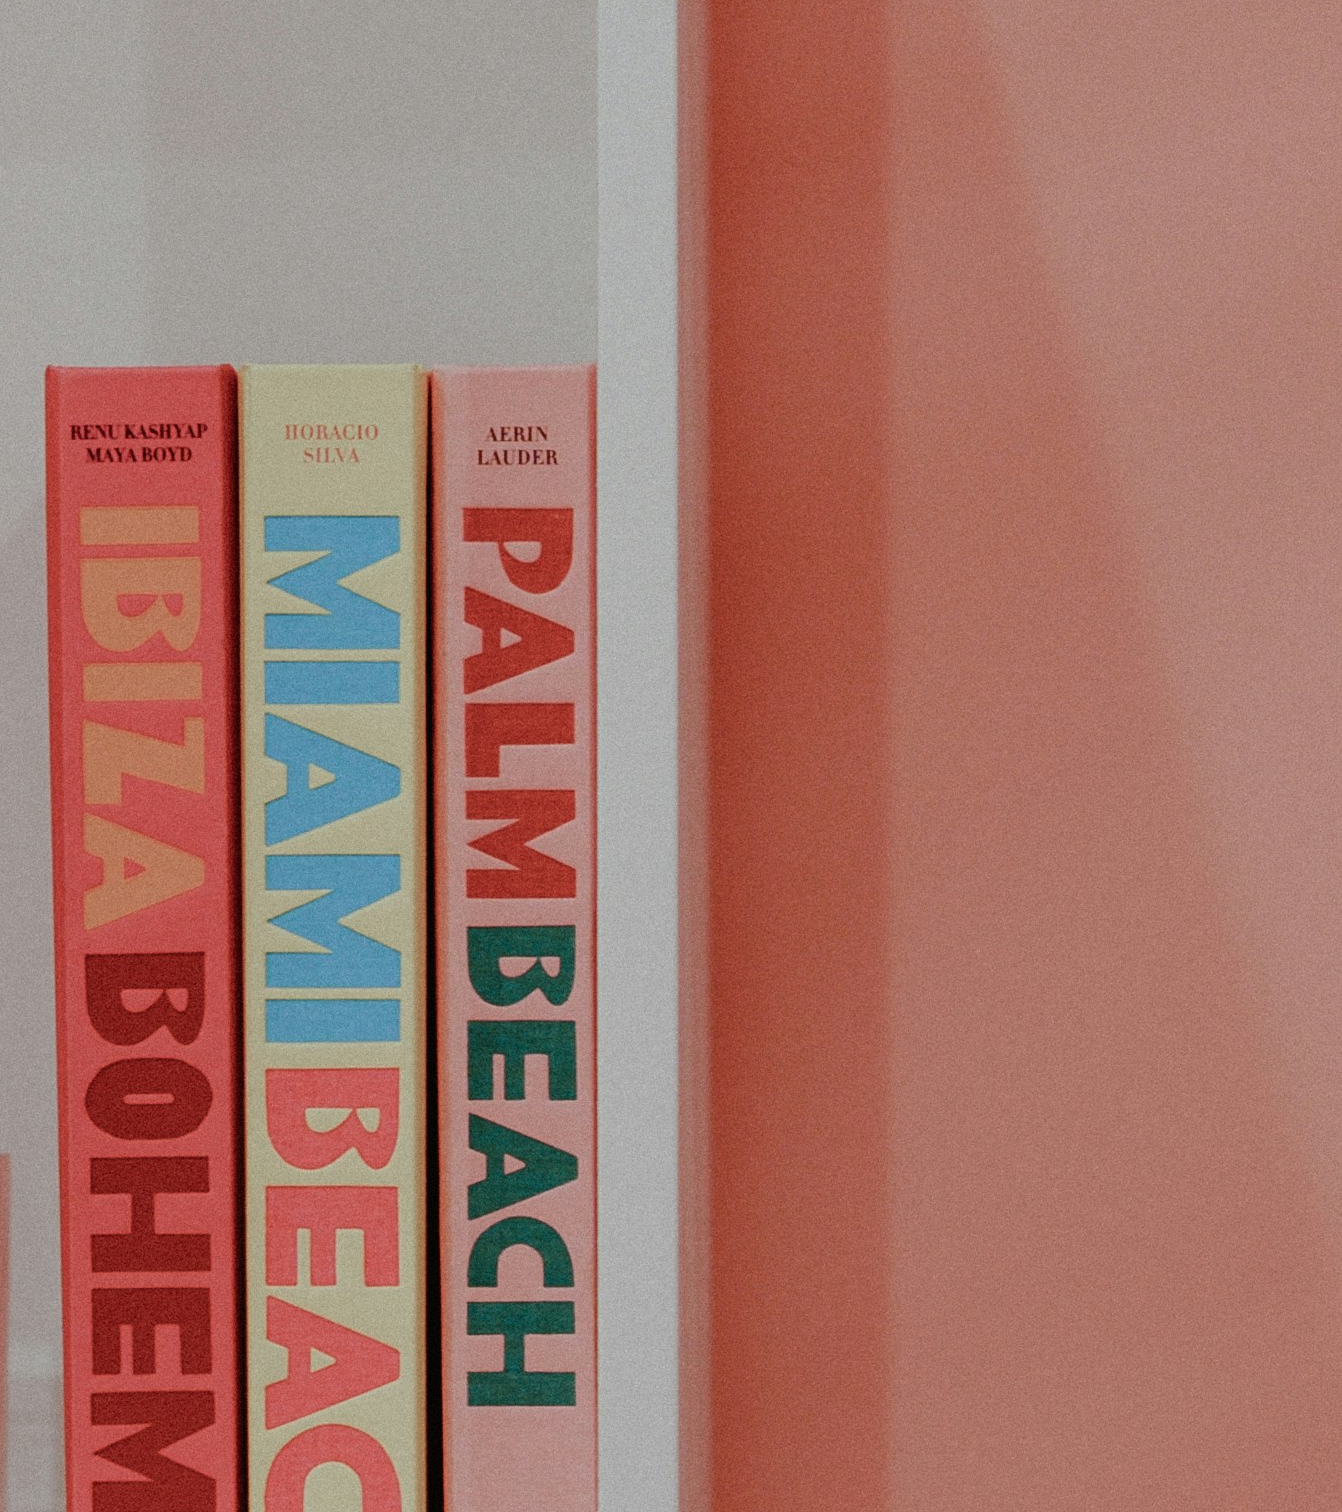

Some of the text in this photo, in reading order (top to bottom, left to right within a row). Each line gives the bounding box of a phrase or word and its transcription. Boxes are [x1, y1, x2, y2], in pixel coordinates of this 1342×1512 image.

[70, 423, 208, 440] RENU KASHYAP
[285, 424, 379, 441] HORACIO
[485, 426, 548, 443] AERIN
[86, 447, 192, 463] MAYA BOYD
[303, 447, 361, 464] SILVA
[477, 449, 559, 466] LAUDER
[79, 505, 206, 931] IBIZA
[264, 515, 401, 1042] MIAMI
[462, 507, 579, 1407] PALM BEACH
